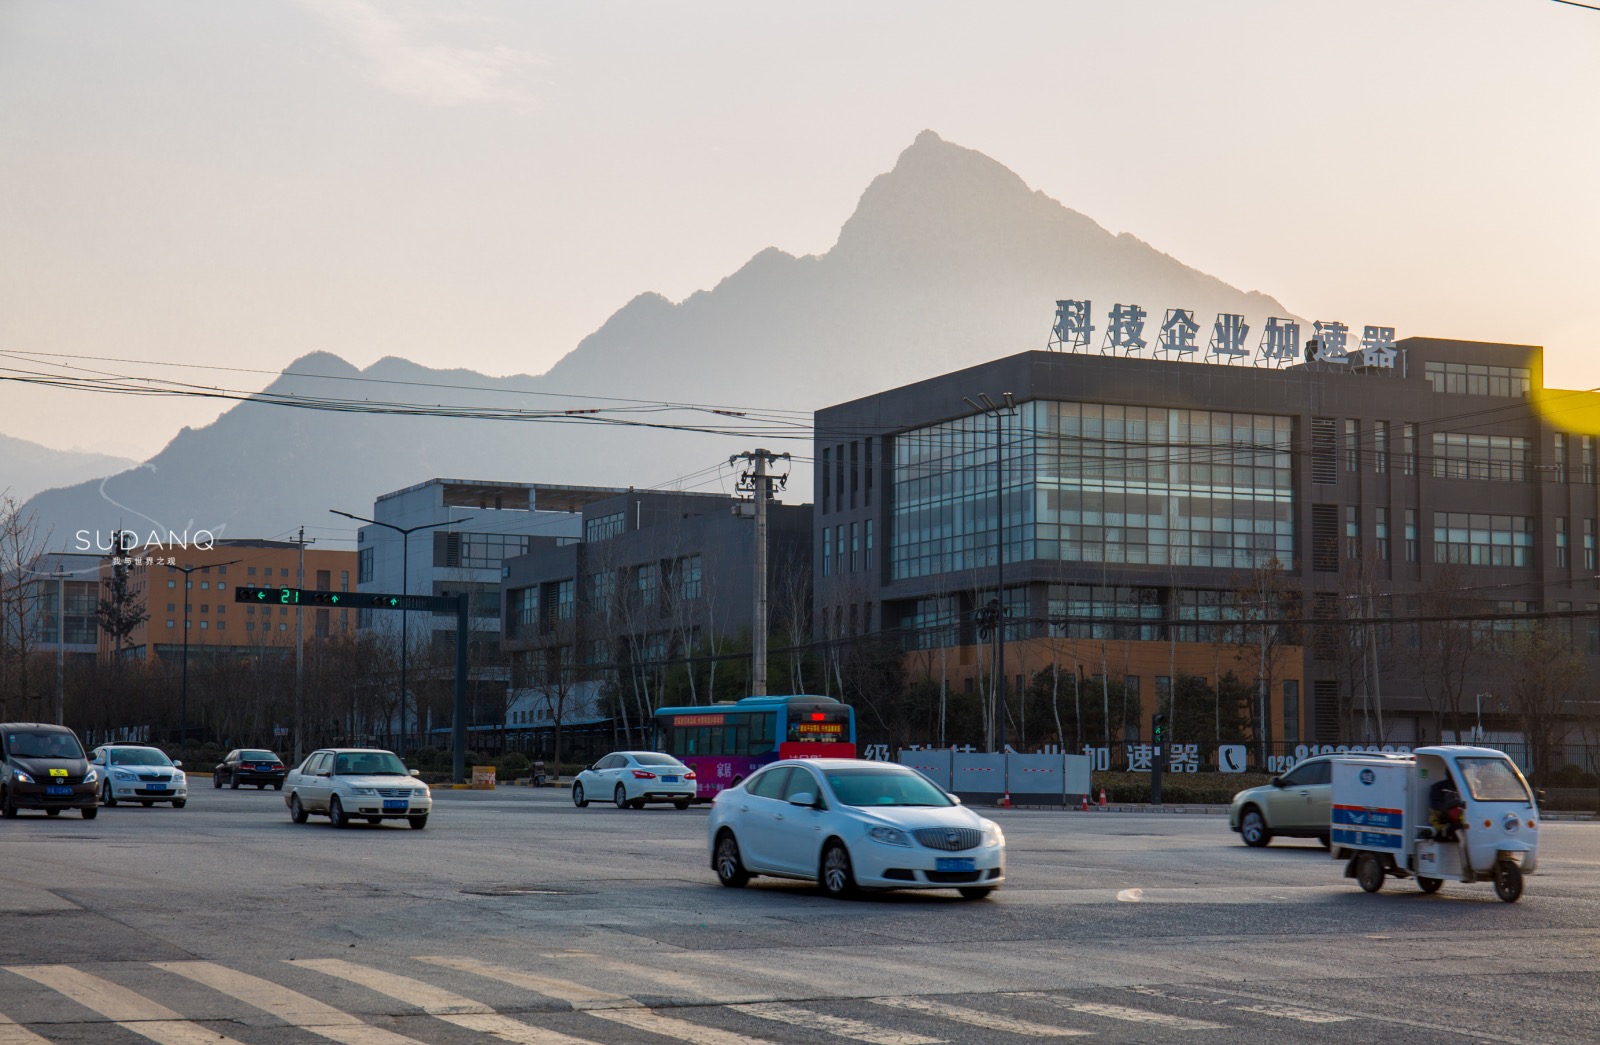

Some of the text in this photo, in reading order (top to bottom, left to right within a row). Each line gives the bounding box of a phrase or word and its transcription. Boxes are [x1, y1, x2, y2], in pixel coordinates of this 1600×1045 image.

[1054, 299, 1398, 369] 科技企业加速器
[280, 589, 299, 604] 21
